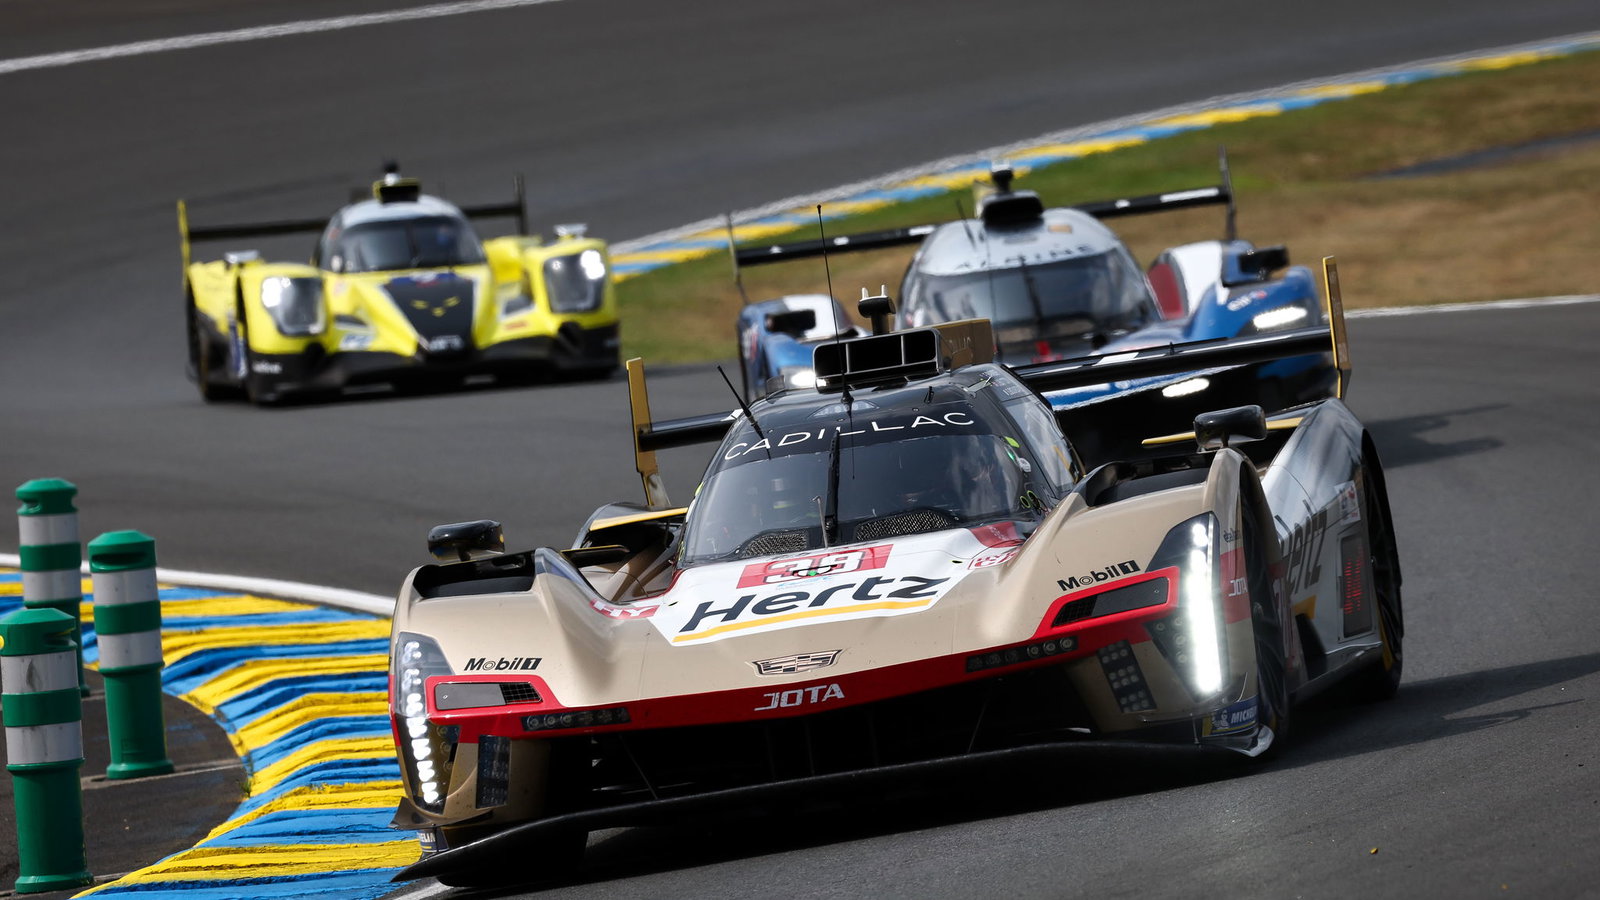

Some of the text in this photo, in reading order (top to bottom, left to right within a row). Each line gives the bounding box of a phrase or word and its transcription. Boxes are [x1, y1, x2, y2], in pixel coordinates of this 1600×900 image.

[725, 412, 975, 460] CADILLAC
[1057, 565, 1120, 592] Mobil
[679, 576, 951, 633] Hertz
[463, 656, 523, 671] Mobil
[753, 683, 845, 711] JOTA
